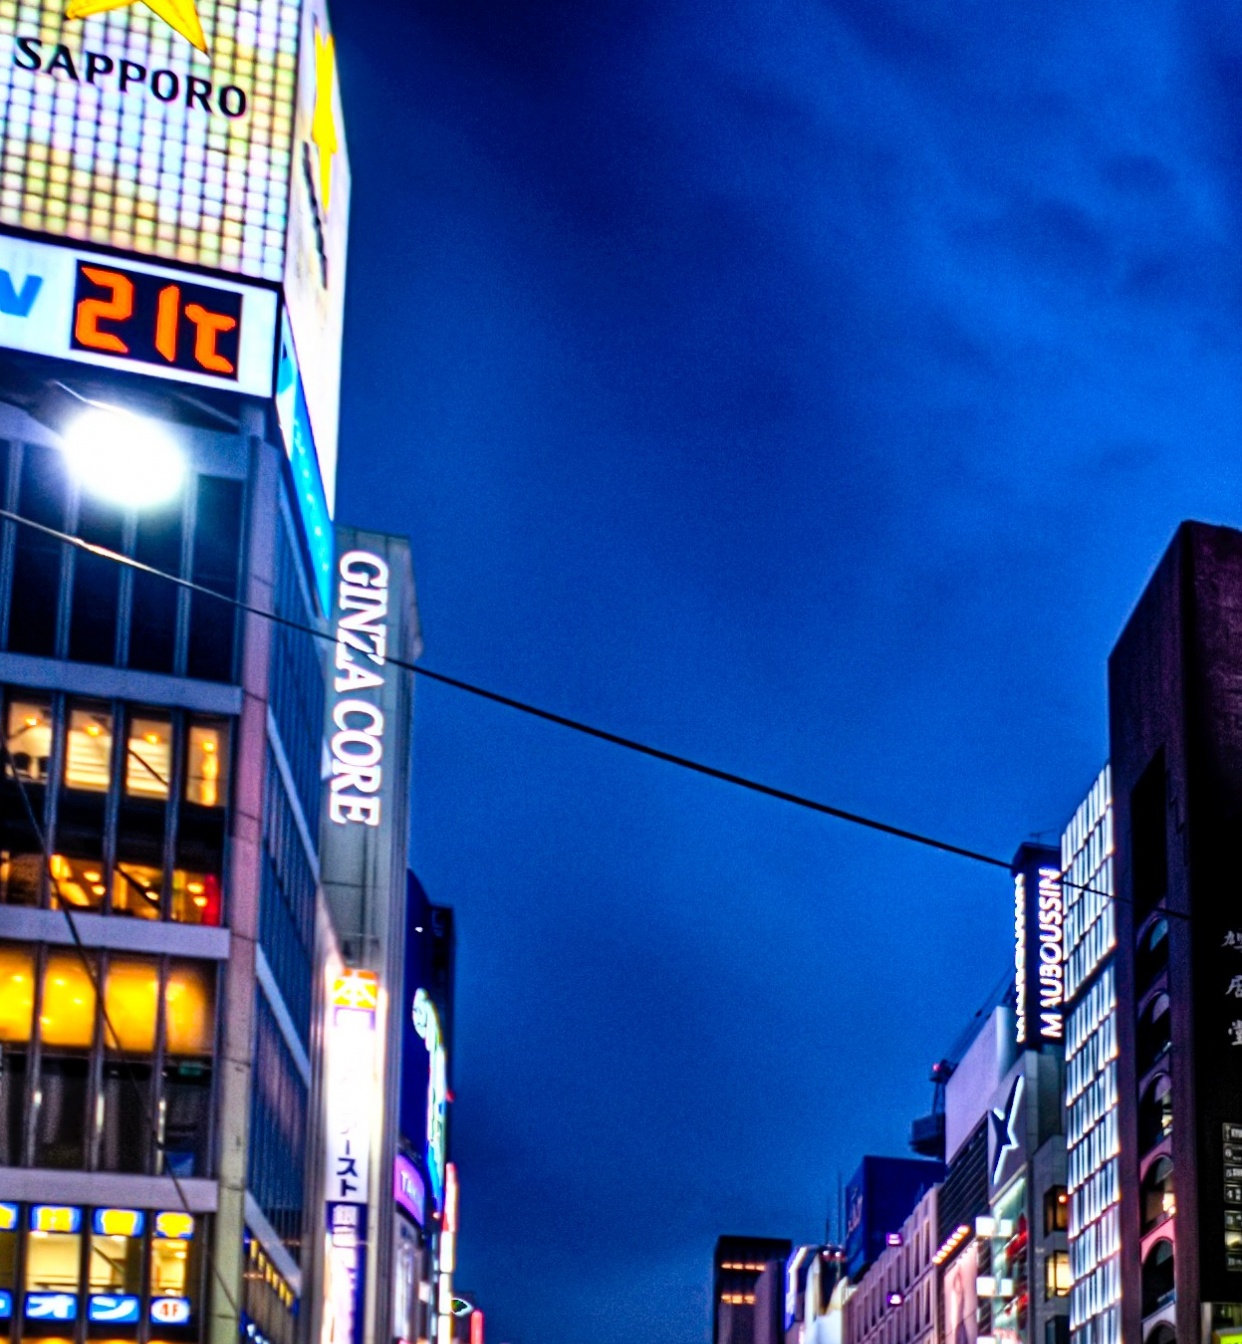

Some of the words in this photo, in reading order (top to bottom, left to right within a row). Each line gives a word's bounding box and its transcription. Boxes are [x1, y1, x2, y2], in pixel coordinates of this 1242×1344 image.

[13, 36, 247, 118] SAPPORO
[336, 550, 389, 692] GINZA
[329, 699, 385, 828] CORE
[1039, 867, 1063, 1039] MAUBOUSSIN
